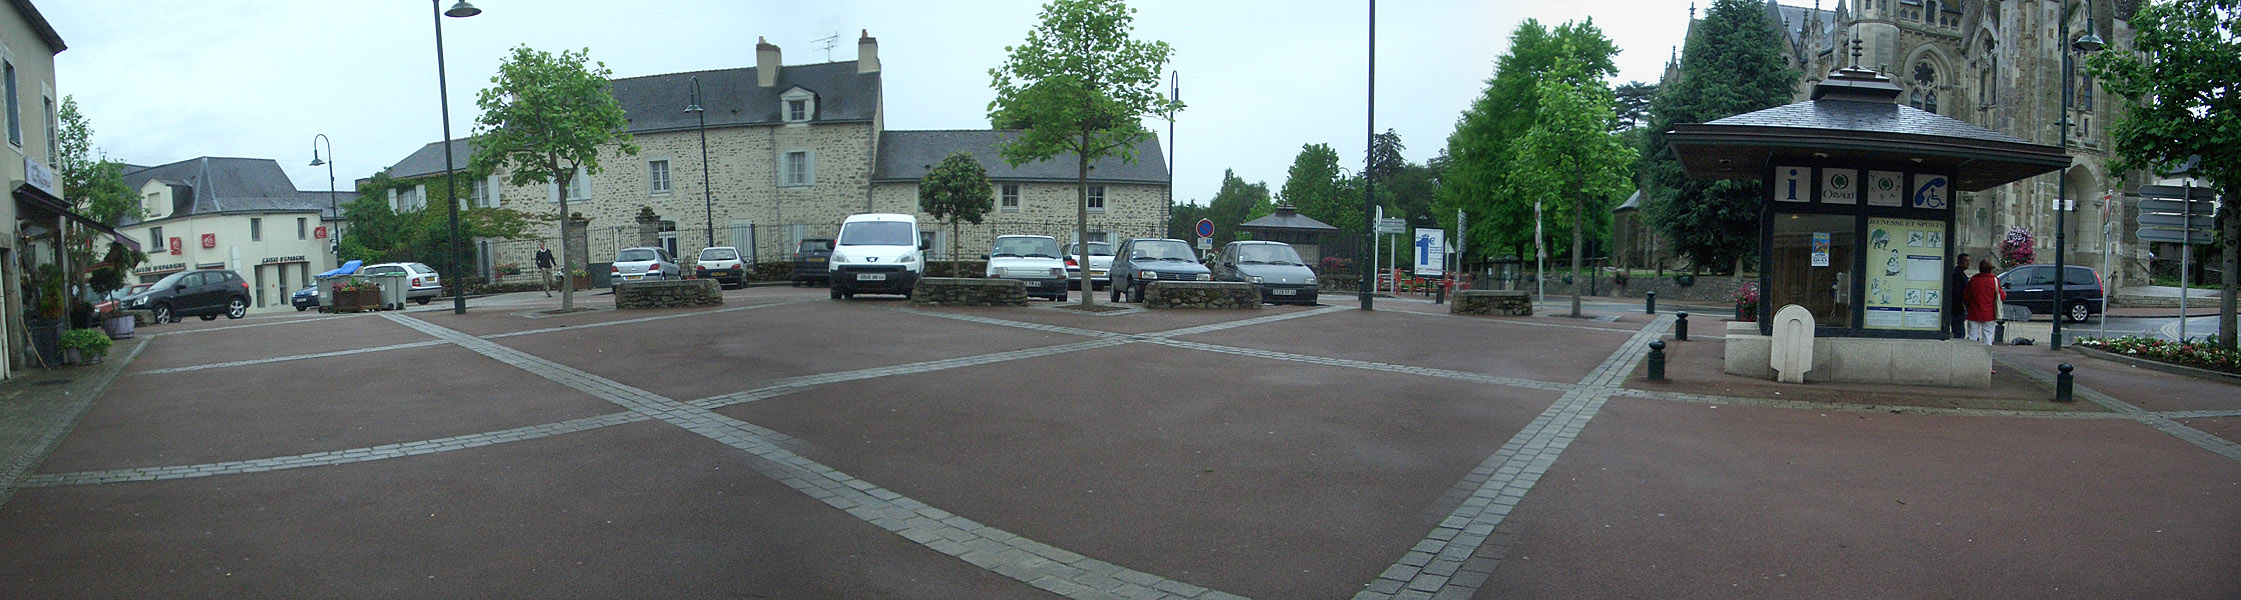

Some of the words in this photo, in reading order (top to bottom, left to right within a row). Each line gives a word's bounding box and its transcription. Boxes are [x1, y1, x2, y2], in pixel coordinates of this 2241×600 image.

[1823, 190, 1855, 200] ORVAULT
[1869, 219, 1904, 227] JEUNESSE
[1416, 237, 1429, 265] 1
[262, 256, 279, 264] CAISSE
